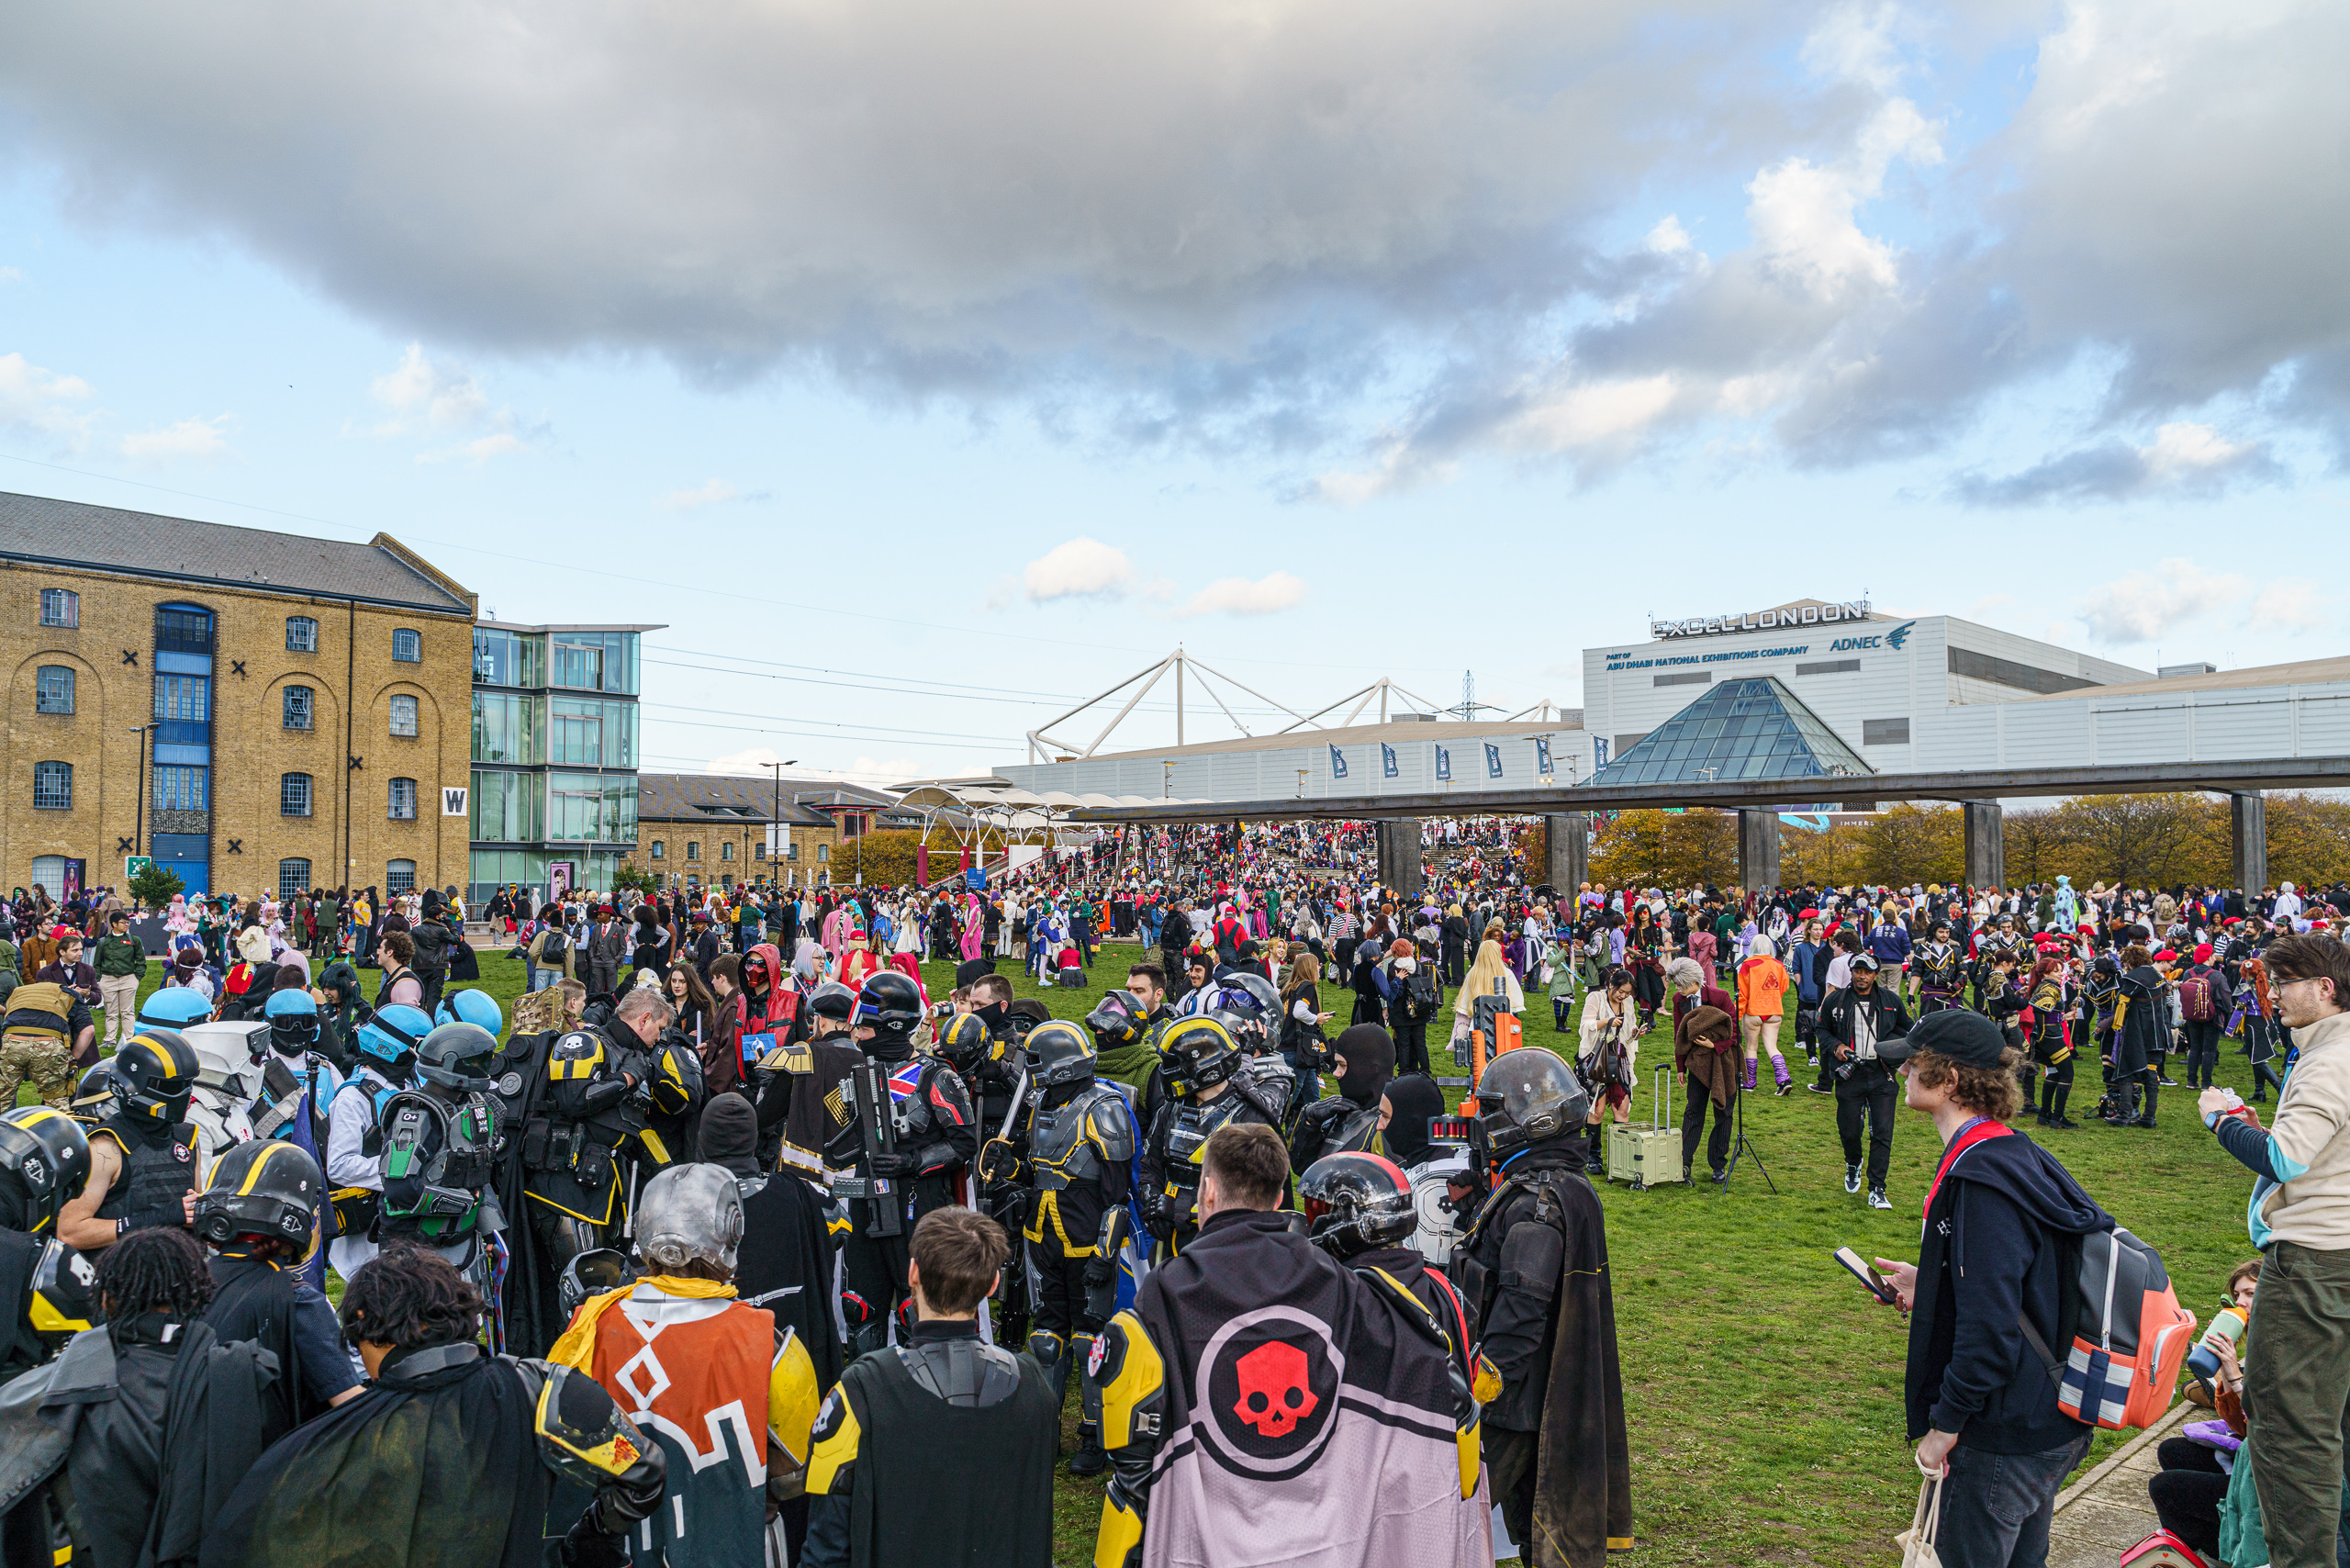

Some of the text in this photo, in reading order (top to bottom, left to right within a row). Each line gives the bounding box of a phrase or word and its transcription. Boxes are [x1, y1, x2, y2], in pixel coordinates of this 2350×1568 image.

[1741, 601, 1863, 630] LONDON
[1830, 635, 1881, 651] ADNEC
[1606, 645, 1808, 670] ABU DHABI NATIONAL EXHIBITIONS COMPANY
[445, 790, 464, 812] W
